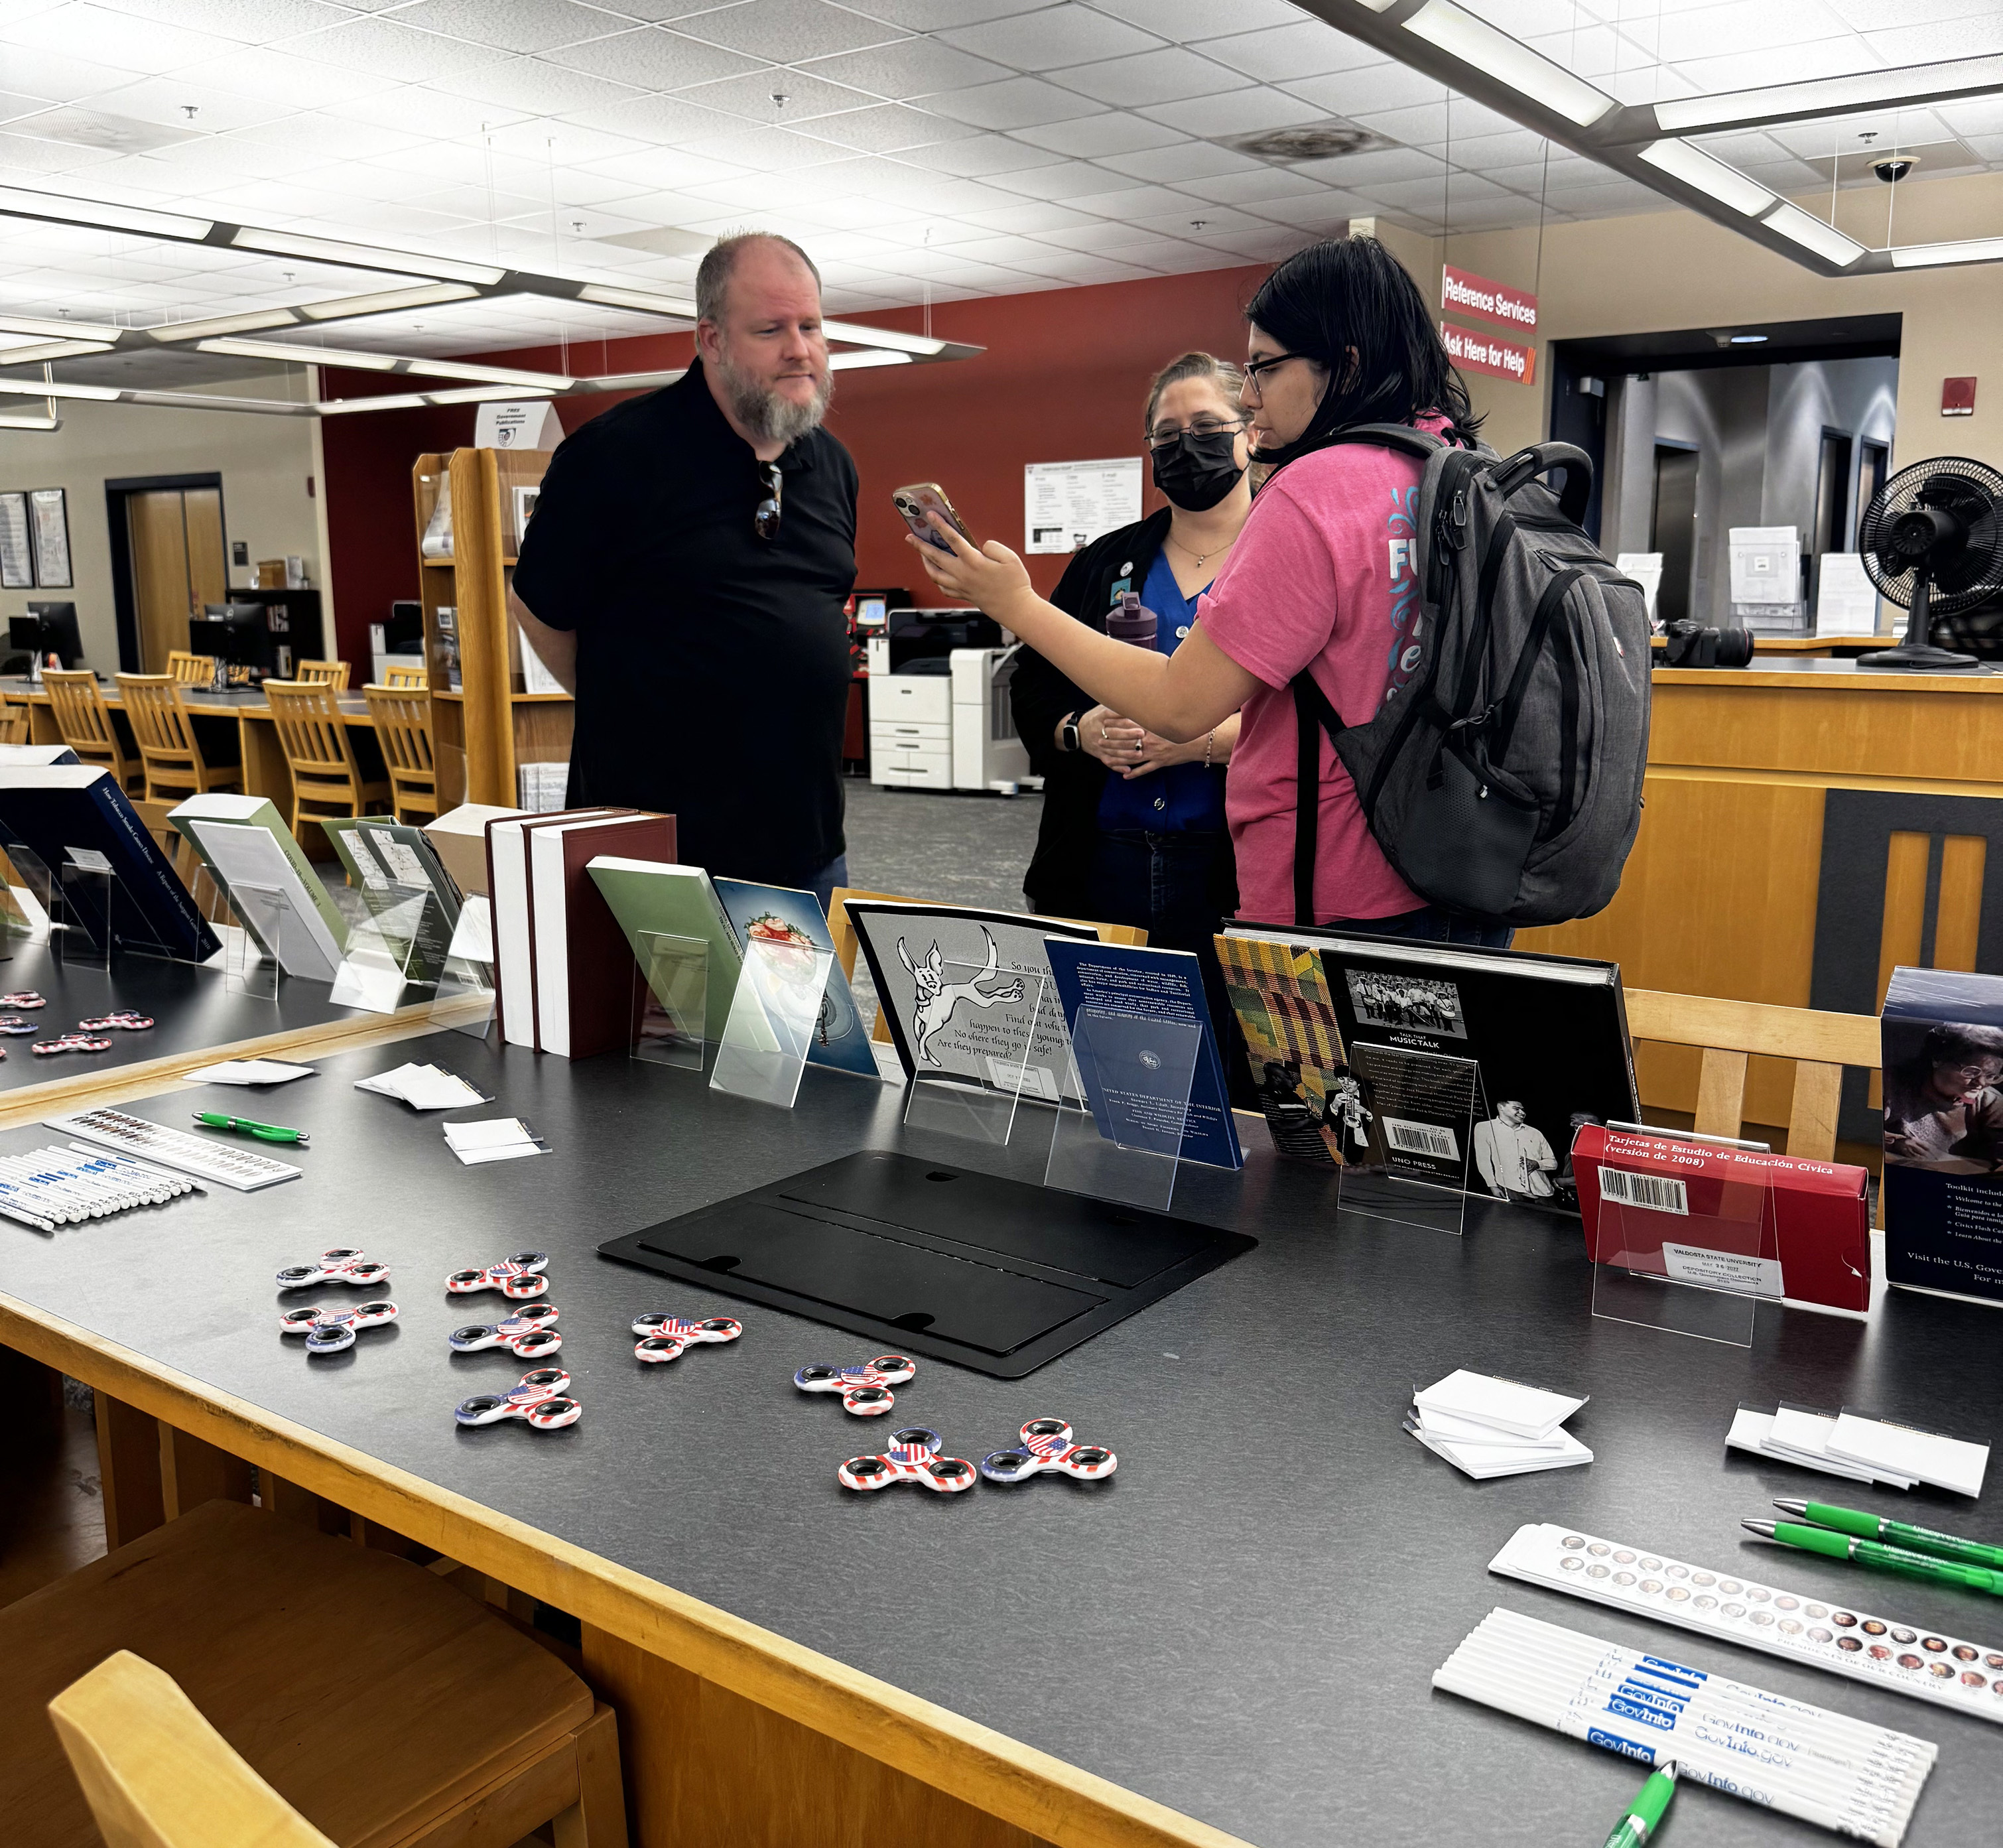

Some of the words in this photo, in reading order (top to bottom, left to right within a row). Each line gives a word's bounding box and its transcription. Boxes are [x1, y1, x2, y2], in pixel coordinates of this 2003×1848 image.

[1445, 277, 1494, 312] Reference
[1496, 293, 1535, 324] Services
[1443, 332, 1461, 357] Ask
[1464, 338, 1487, 363] Here
[1488, 344, 1502, 367] for
[1504, 350, 1525, 377] Help
[970, 1019, 1000, 1033] happen
[1006, 1014, 1025, 1023] Find
[938, 1039, 952, 1047] Are
[954, 1041, 972, 1055] they
[973, 1047, 1012, 1059] prepared?
[992, 1035, 1009, 1050] they
[1012, 1042, 1021, 1051] go
[1034, 1045, 1052, 1056] safe!
[1605, 1143, 1649, 1158] (versión
[1671, 1155, 1705, 1168] 2008)
[1609, 1135, 1650, 1149] Tarjetas
[1671, 1145, 1712, 1157] Estudio
[1734, 1154, 1793, 1169] Educación
[1797, 1163, 1833, 1175] Cívica
[1413, 1161, 1436, 1169] PRESS
[1945, 1183, 1973, 1192] Toolkit
[1955, 1196, 1983, 1205] Welcome
[1955, 1206, 1990, 1216] Bienvenidos
[1673, 1248, 1705, 1259] VALDOSTA
[1907, 1252, 1930, 1262] Visit
[1954, 1260, 1973, 1270] U.S.
[1683, 1266, 1721, 1276] DEPOSITORY
[1724, 1272, 1762, 1282] COLLECTION
[1612, 1699, 1672, 1728] GovInfo
[1590, 1731, 1651, 1760] GovInfo
